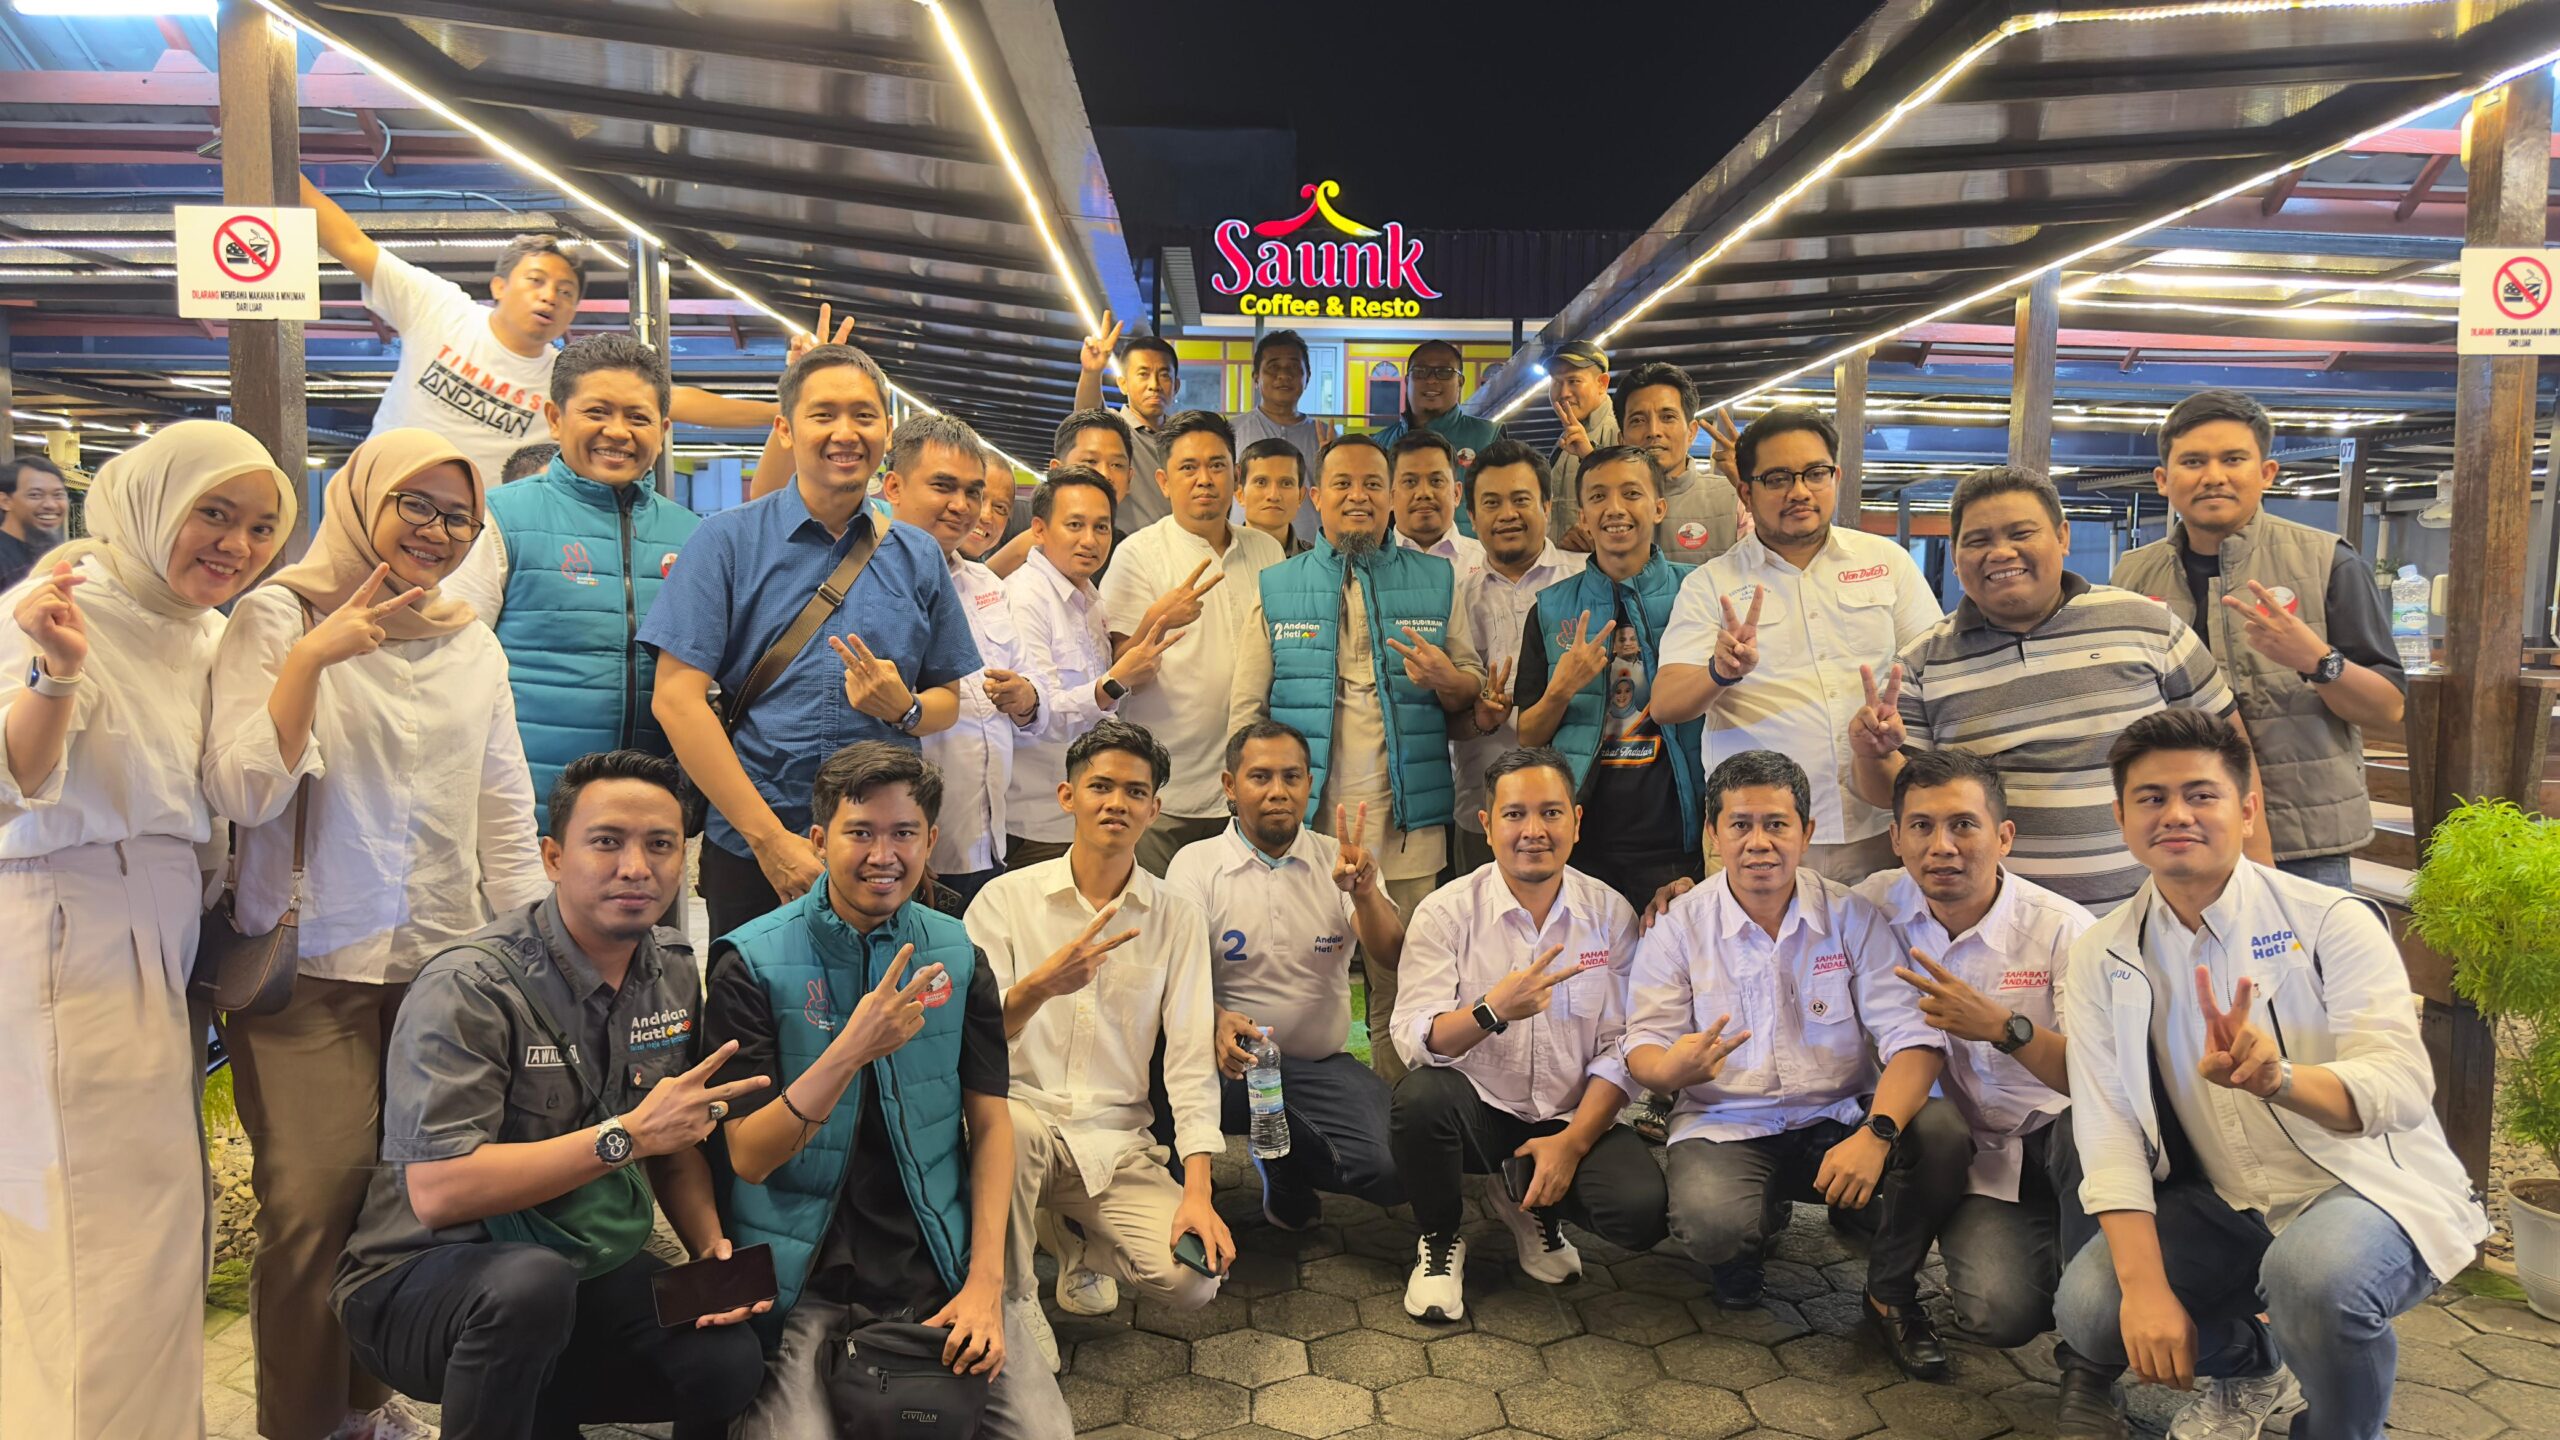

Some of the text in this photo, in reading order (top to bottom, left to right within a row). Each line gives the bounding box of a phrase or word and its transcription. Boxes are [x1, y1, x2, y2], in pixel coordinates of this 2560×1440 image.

[1211, 219, 1443, 299] Saunk
[191, 290, 219, 300] DILARANG
[220, 290, 247, 300] MEMBAWA
[248, 291, 275, 300] MAKANAN
[281, 291, 306, 301] MINUMAN
[236, 302, 263, 312] DARI LUAR
[1239, 293, 1421, 318] Coffee & Resto
[419, 370, 533, 438] ANDALAN
[2341, 442, 2355, 458] 07
[1274, 622, 1283, 640] 2
[1284, 622, 1320, 631] Andalan
[1284, 630, 1301, 638] Hati
[2251, 930, 2293, 947] Anda
[1222, 929, 1248, 962] 2
[1314, 945, 1333, 953] Hati
[2252, 940, 2287, 960] Hati
[1580, 950, 1609, 960] SAHAB
[1814, 953, 1844, 963] SAHAB
[1579, 957, 1609, 966] ANDAL
[1813, 960, 1847, 971] ANDAL
[2004, 970, 2049, 979] SAHABAT
[2001, 978, 2049, 986] ANDALAN
[631, 1008, 688, 1029] Andalan
[630, 1026, 667, 1044] Hati
[901, 1410, 938, 1423] CIVILIAN
